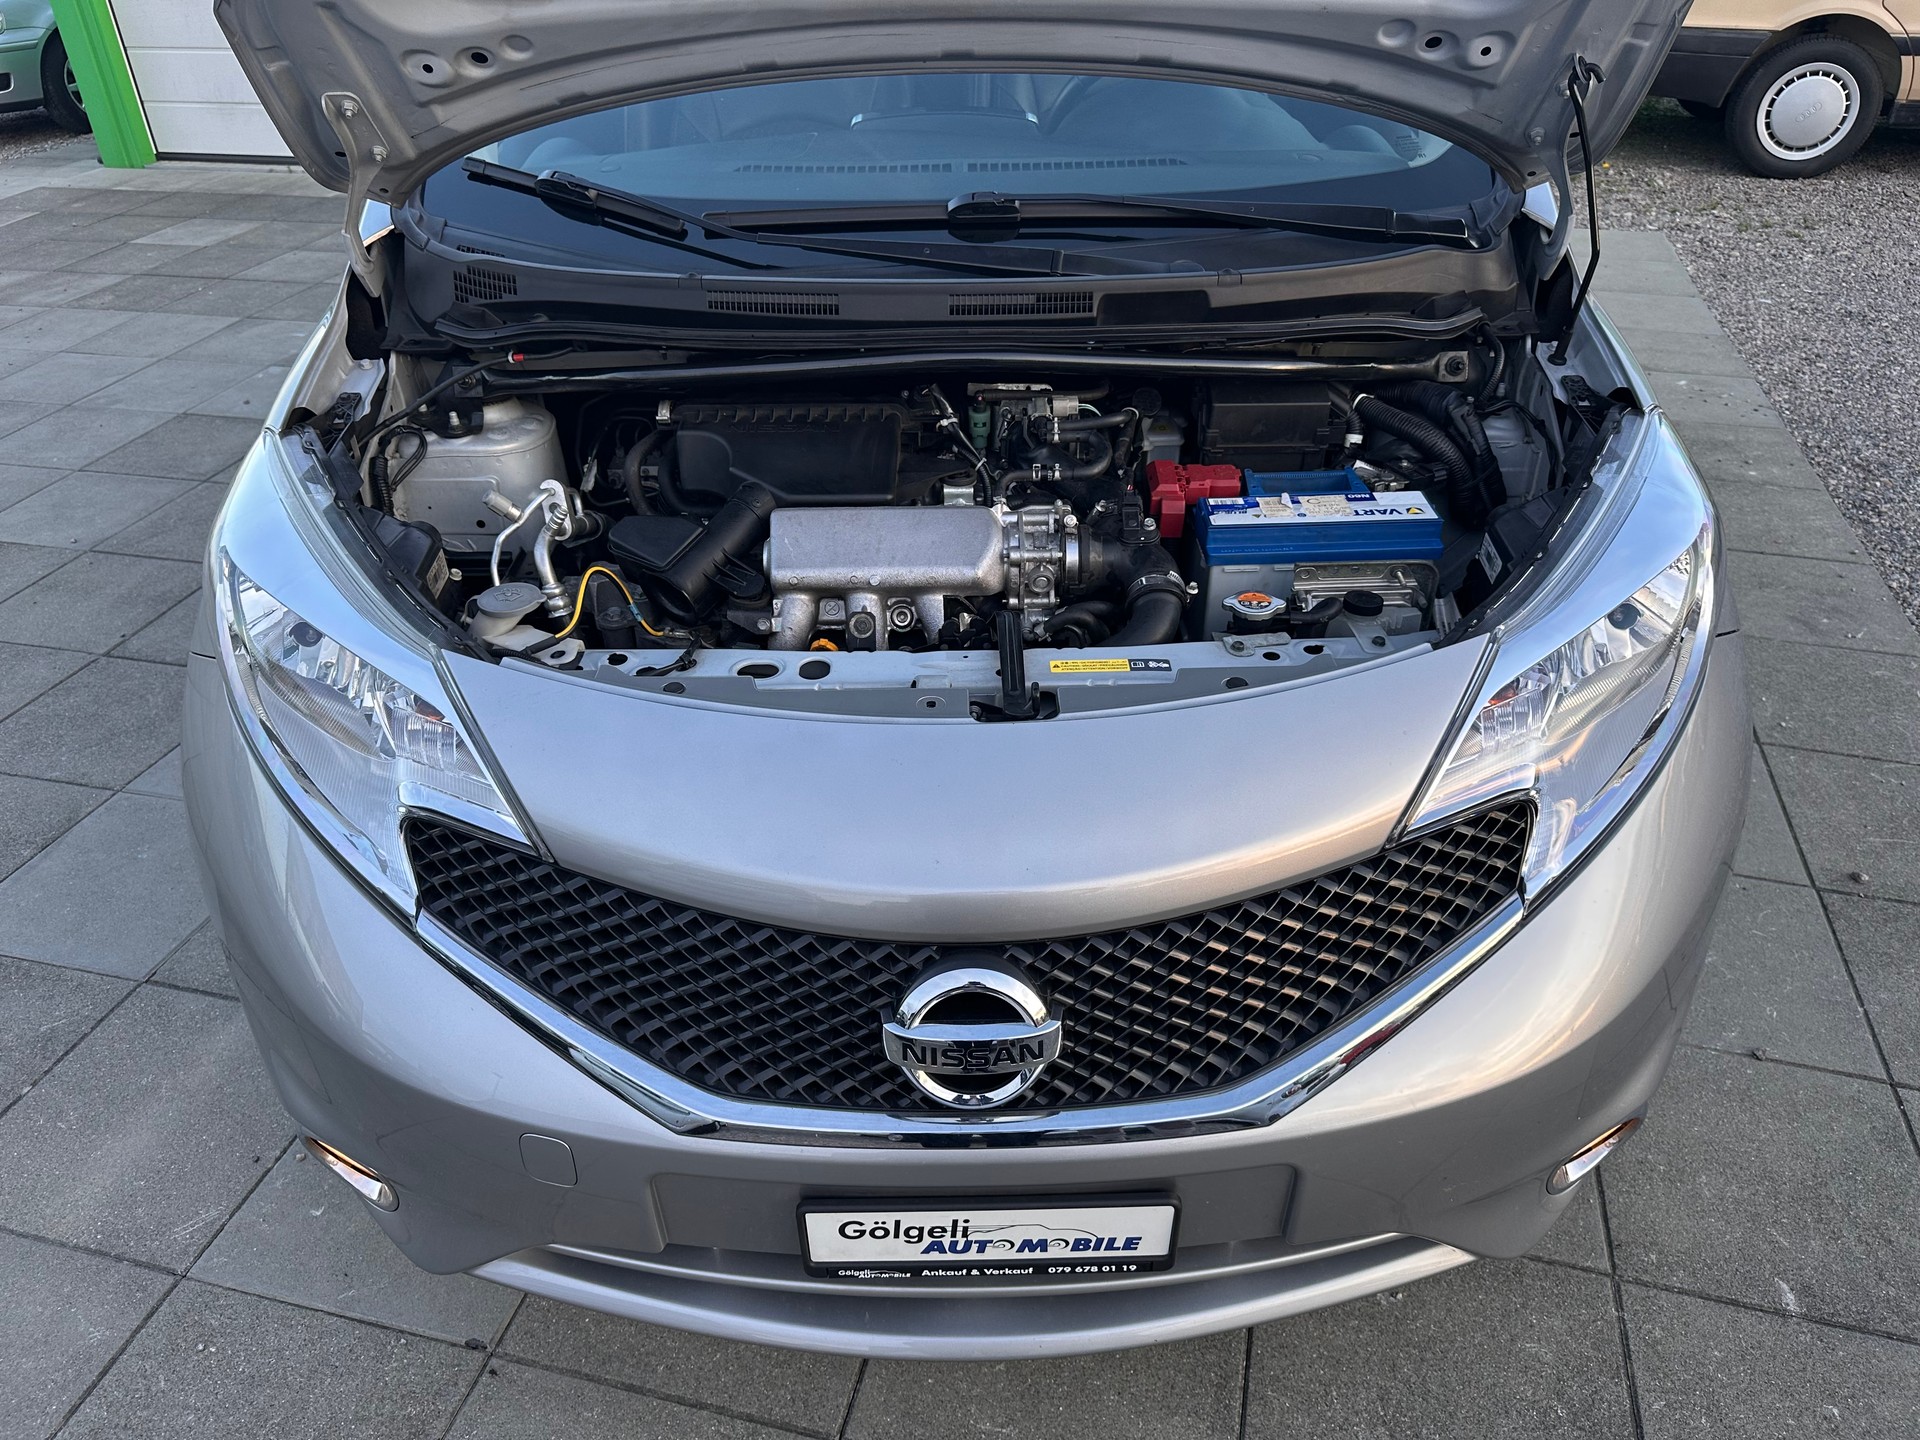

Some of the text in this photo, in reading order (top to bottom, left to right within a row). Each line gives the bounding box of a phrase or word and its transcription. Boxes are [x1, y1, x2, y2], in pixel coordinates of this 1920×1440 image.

[728, 424, 841, 433] NISSAN
[1353, 508, 1403, 516] VART
[901, 1040, 1044, 1069] NISSAN
[838, 1219, 971, 1244] Gölgeli
[920, 1236, 1142, 1255] AUTOMOBILE
[921, 1263, 1137, 1277] Ankauf & Verkauf 079 678 01 19
